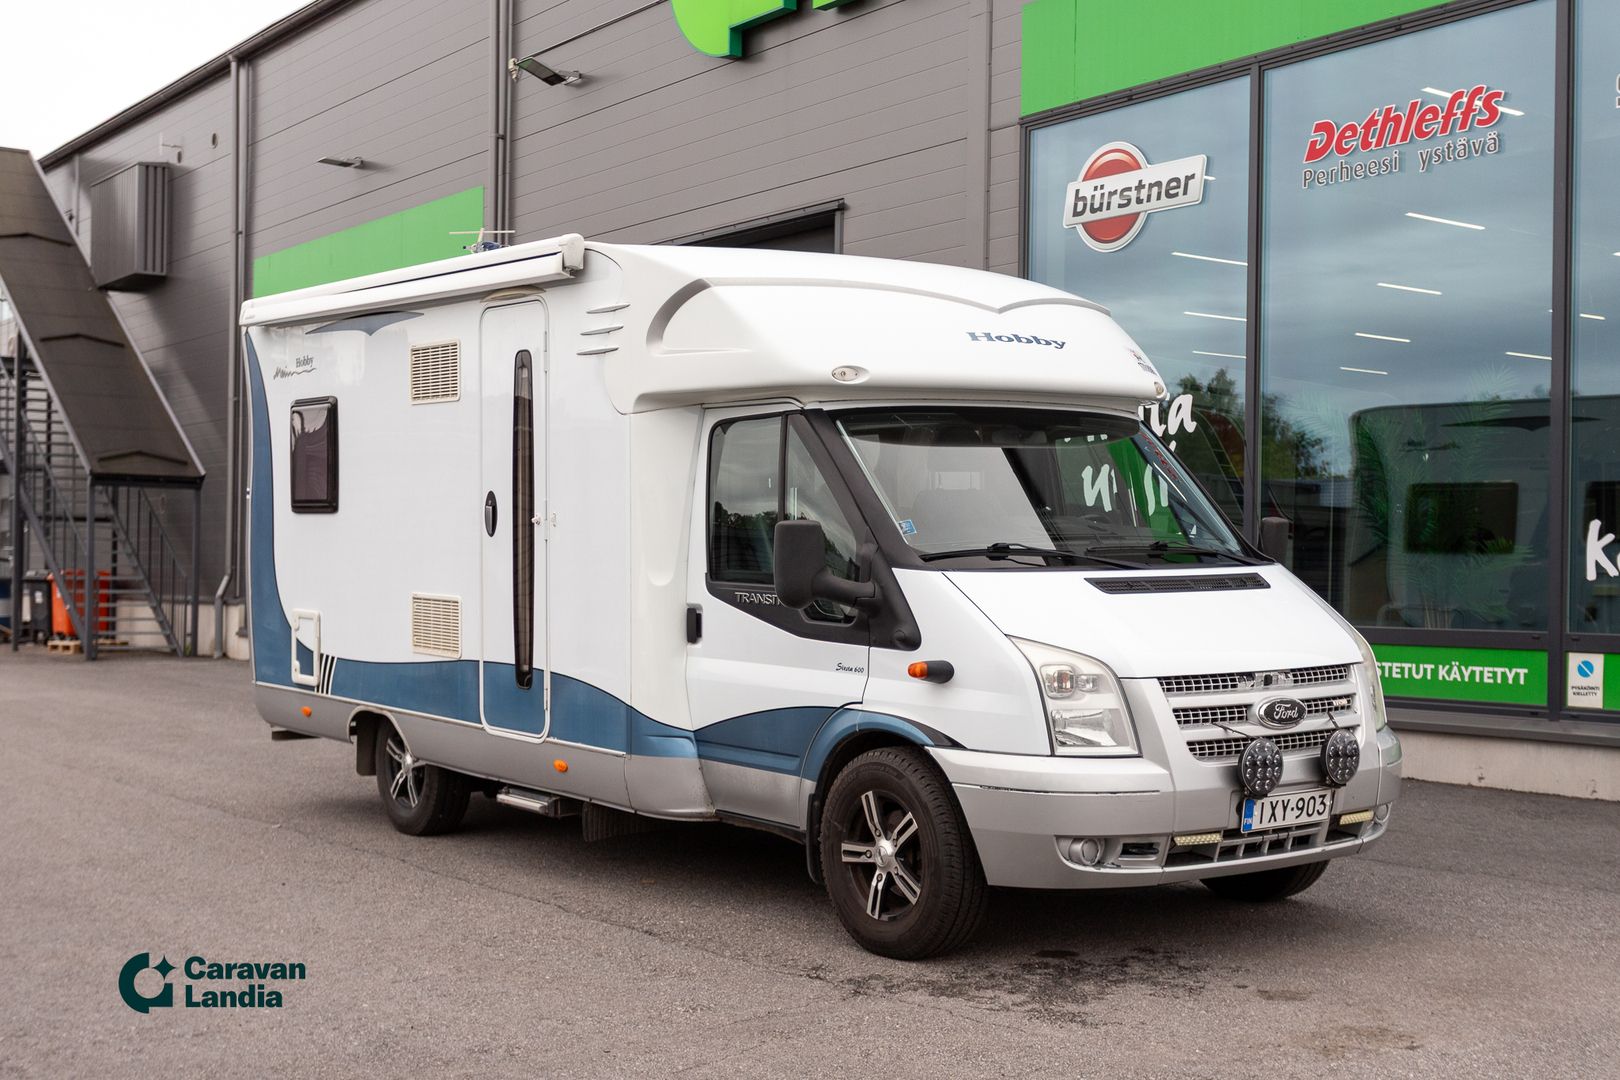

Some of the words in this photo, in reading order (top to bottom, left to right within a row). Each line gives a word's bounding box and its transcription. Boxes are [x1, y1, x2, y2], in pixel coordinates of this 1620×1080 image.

[1303, 85, 1504, 163] Dethleffs
[1302, 151, 1399, 188] Perheesi
[1419, 132, 1499, 171] ystävä
[1072, 173, 1195, 217] bürstner
[966, 332, 1066, 349] Hobby
[1438, 661, 1528, 685] KÄYTETYT
[1273, 703, 1298, 720] Ford
[1259, 794, 1328, 824] IXY-903
